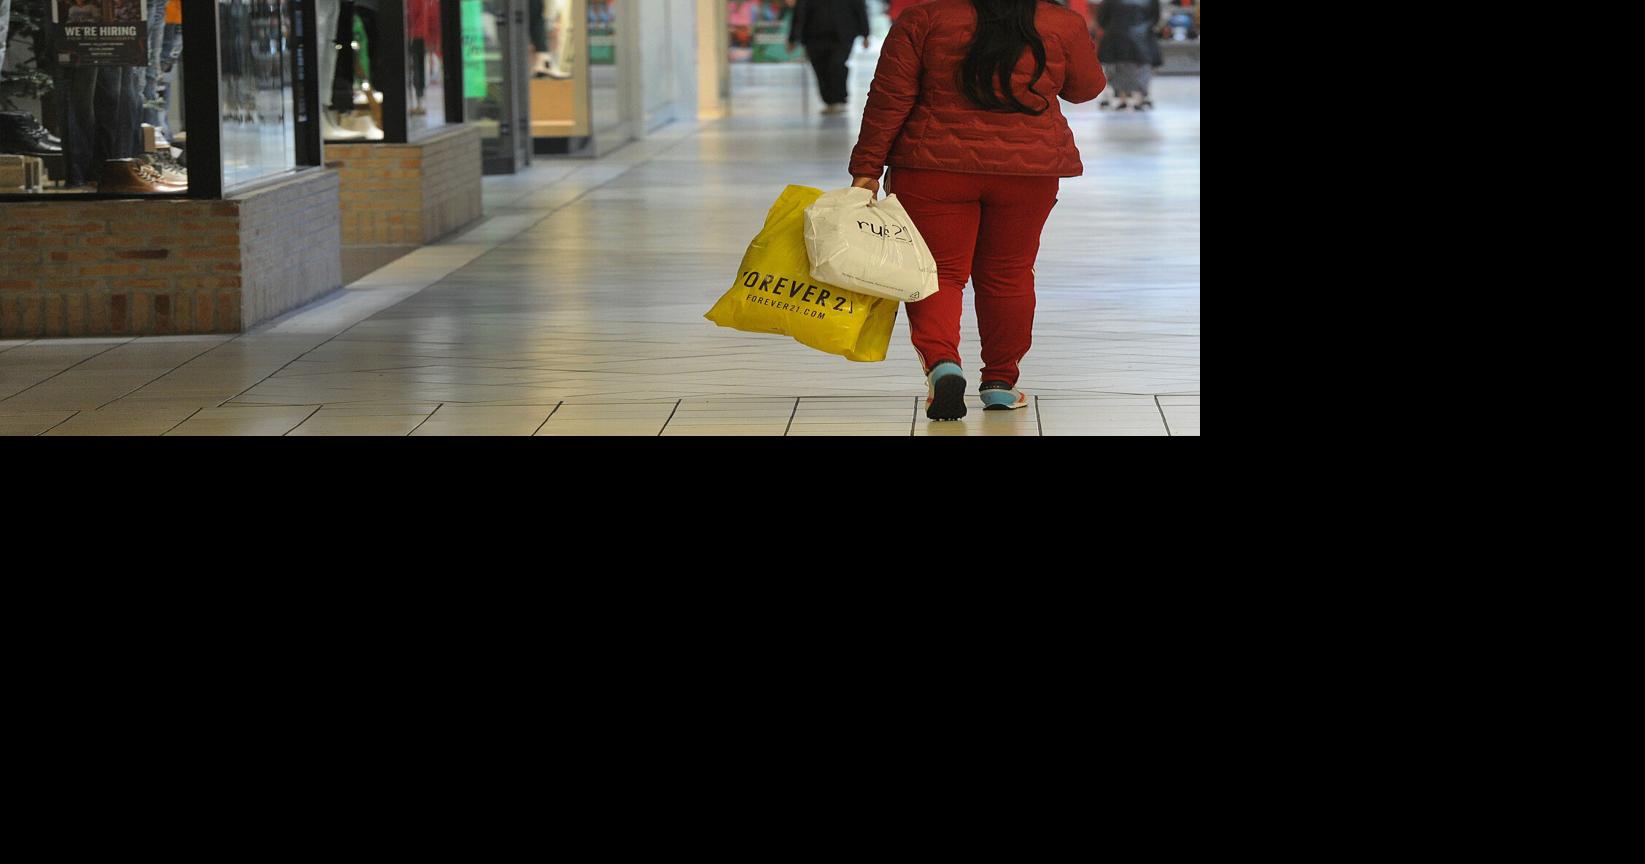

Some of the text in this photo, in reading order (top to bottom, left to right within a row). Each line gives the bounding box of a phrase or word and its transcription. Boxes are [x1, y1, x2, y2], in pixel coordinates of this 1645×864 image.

[64, 26, 137, 37] WE'RE HIRING
[743, 271, 831, 307] OREVER
[746, 294, 826, 320] FOREVER21.COM
